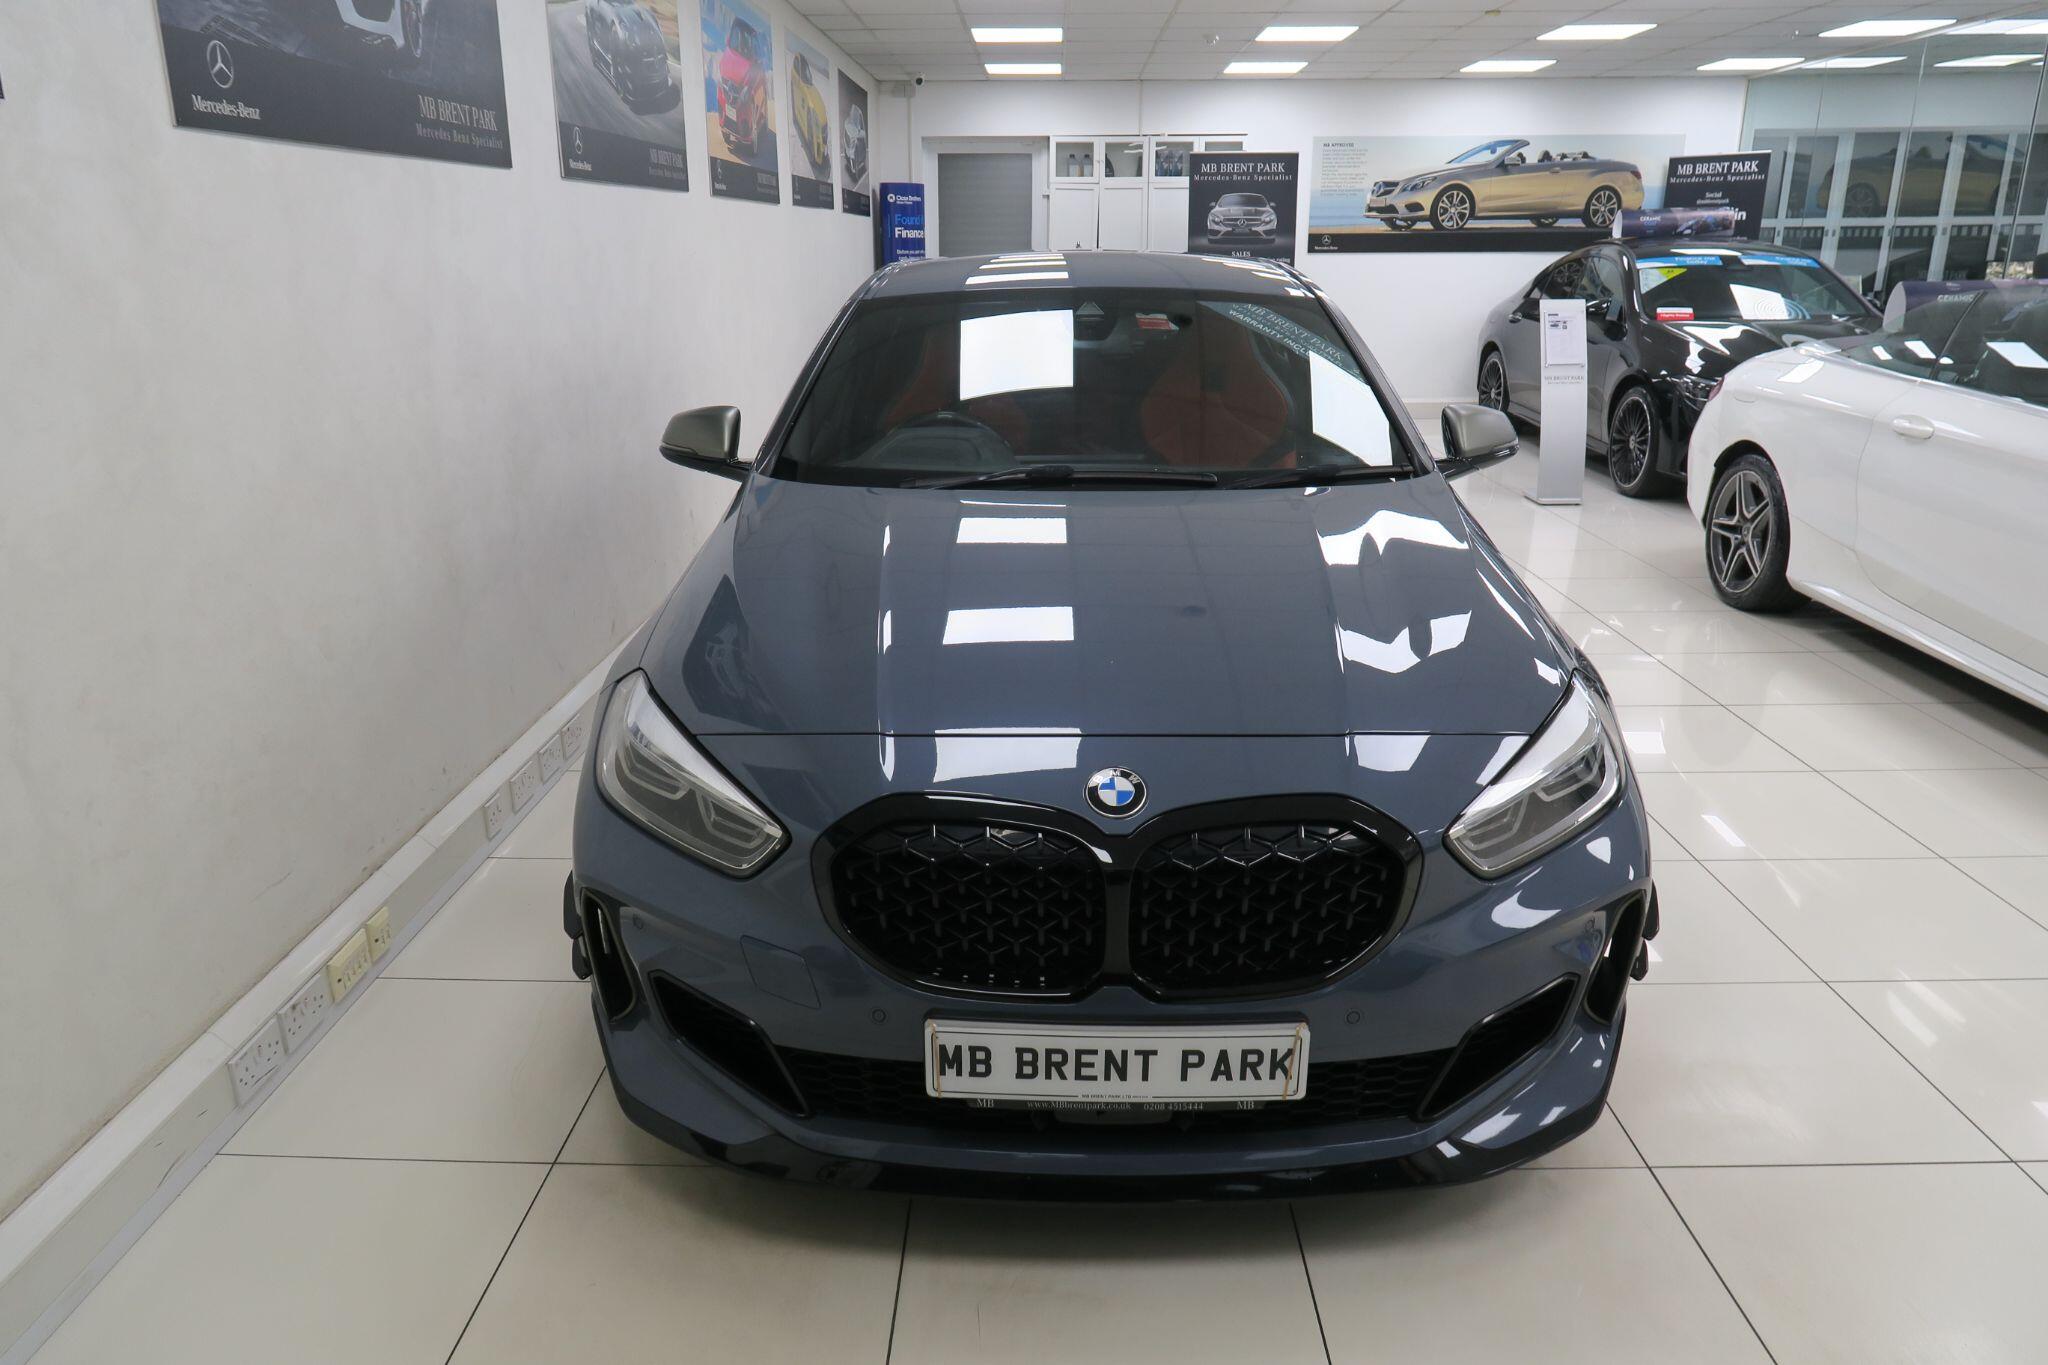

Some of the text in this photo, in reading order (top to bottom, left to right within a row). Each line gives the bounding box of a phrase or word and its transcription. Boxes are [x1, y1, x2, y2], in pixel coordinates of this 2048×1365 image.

[192, 94, 261, 120] Mercedes-Benz
[417, 94, 498, 131] MB BRENT PARK
[1201, 162, 1286, 173] MB BRENT PARK
[1677, 160, 1759, 176] MB BRENT PARK
[1669, 173, 1765, 184] Mercedes-Benz Specialist
[1229, 309, 1284, 338] WARRANTY
[1266, 313, 1312, 339] BRENT
[1311, 337, 1345, 361] PARK
[1092, 770, 1141, 784] BMW
[939, 1044, 1293, 1082] MB BRENT PARK
[976, 1098, 995, 1109] MB
[1027, 1100, 1132, 1111] www.MBbrentpark.co.uk
[1143, 1102, 1165, 1111] 0208
[1236, 1100, 1256, 1110] MB
